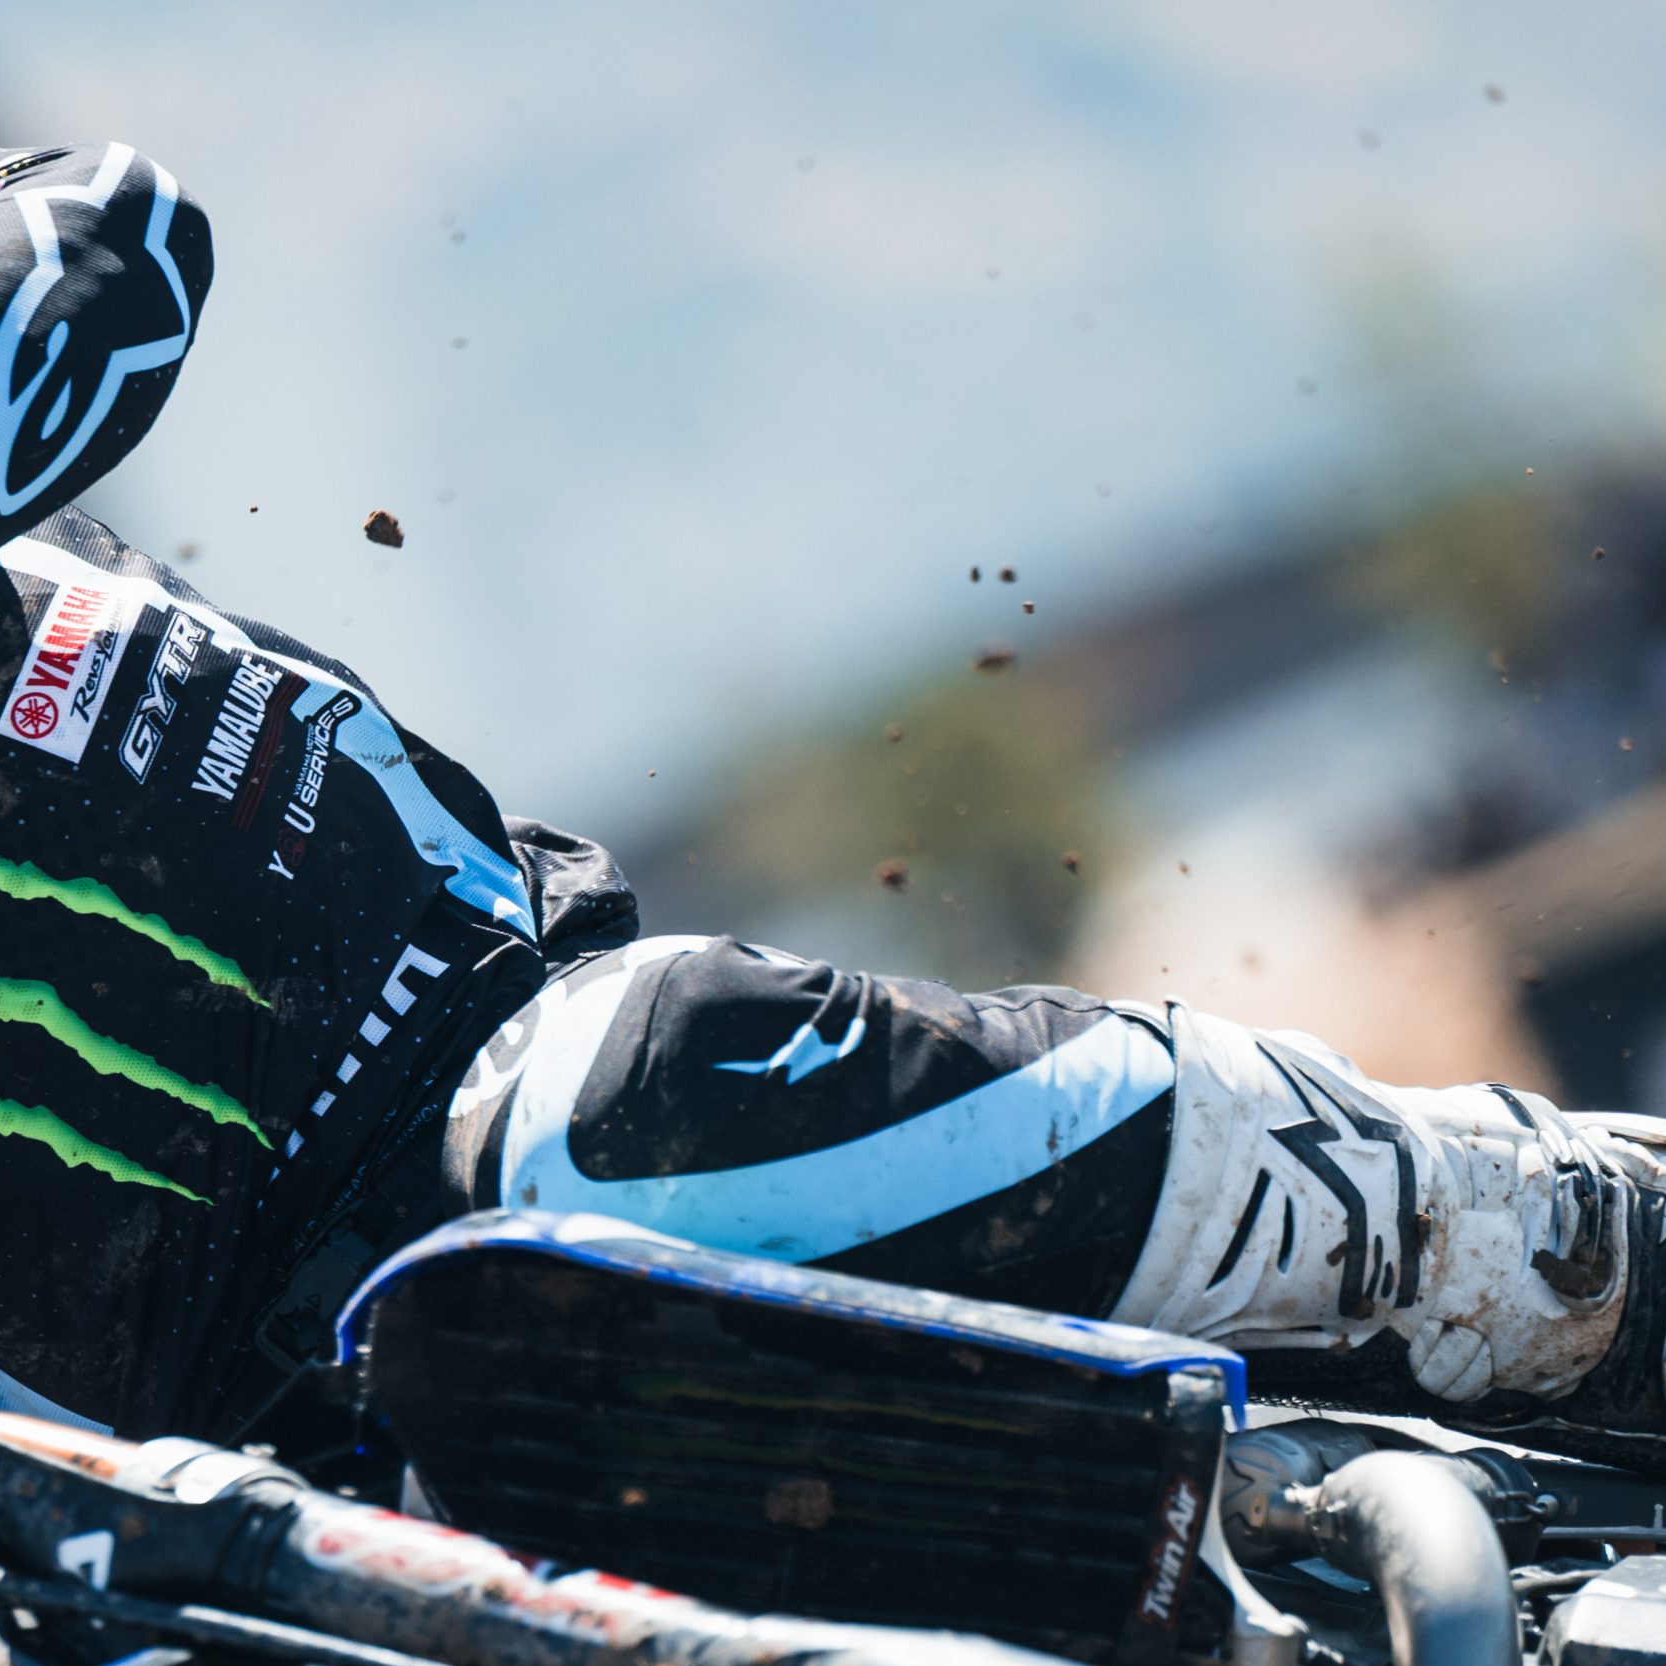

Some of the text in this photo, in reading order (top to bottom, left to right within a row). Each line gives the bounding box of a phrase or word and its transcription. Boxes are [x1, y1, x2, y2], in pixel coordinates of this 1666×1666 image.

[25, 585, 111, 691] YAMAHA
[120, 611, 206, 783] GYTR
[190, 654, 284, 801] YAMALUBE
[299, 697, 355, 808] SERVICES
[1142, 1481, 1197, 1620] Twin Air
